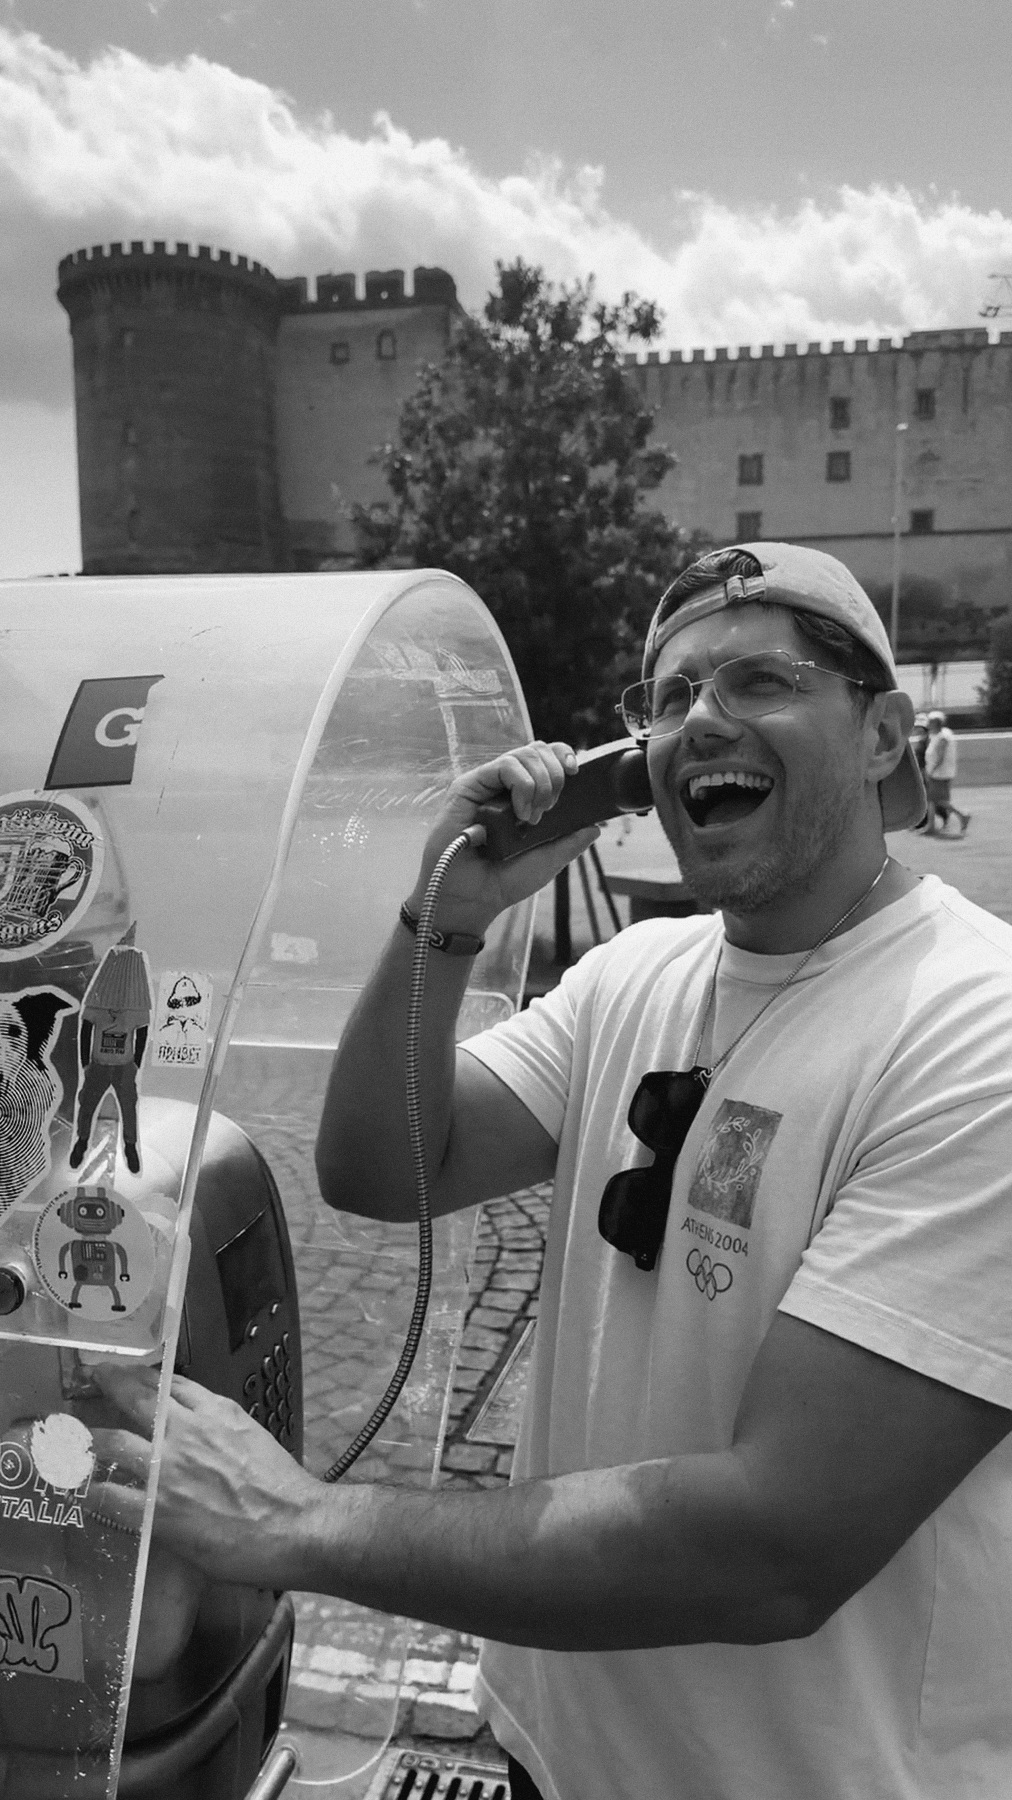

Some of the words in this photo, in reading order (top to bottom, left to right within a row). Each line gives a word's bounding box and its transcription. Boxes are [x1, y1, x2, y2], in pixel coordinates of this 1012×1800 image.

[95, 706, 145, 748] G
[715, 1231, 749, 1257] 2004
[0, 1494, 85, 1529] TALIA
